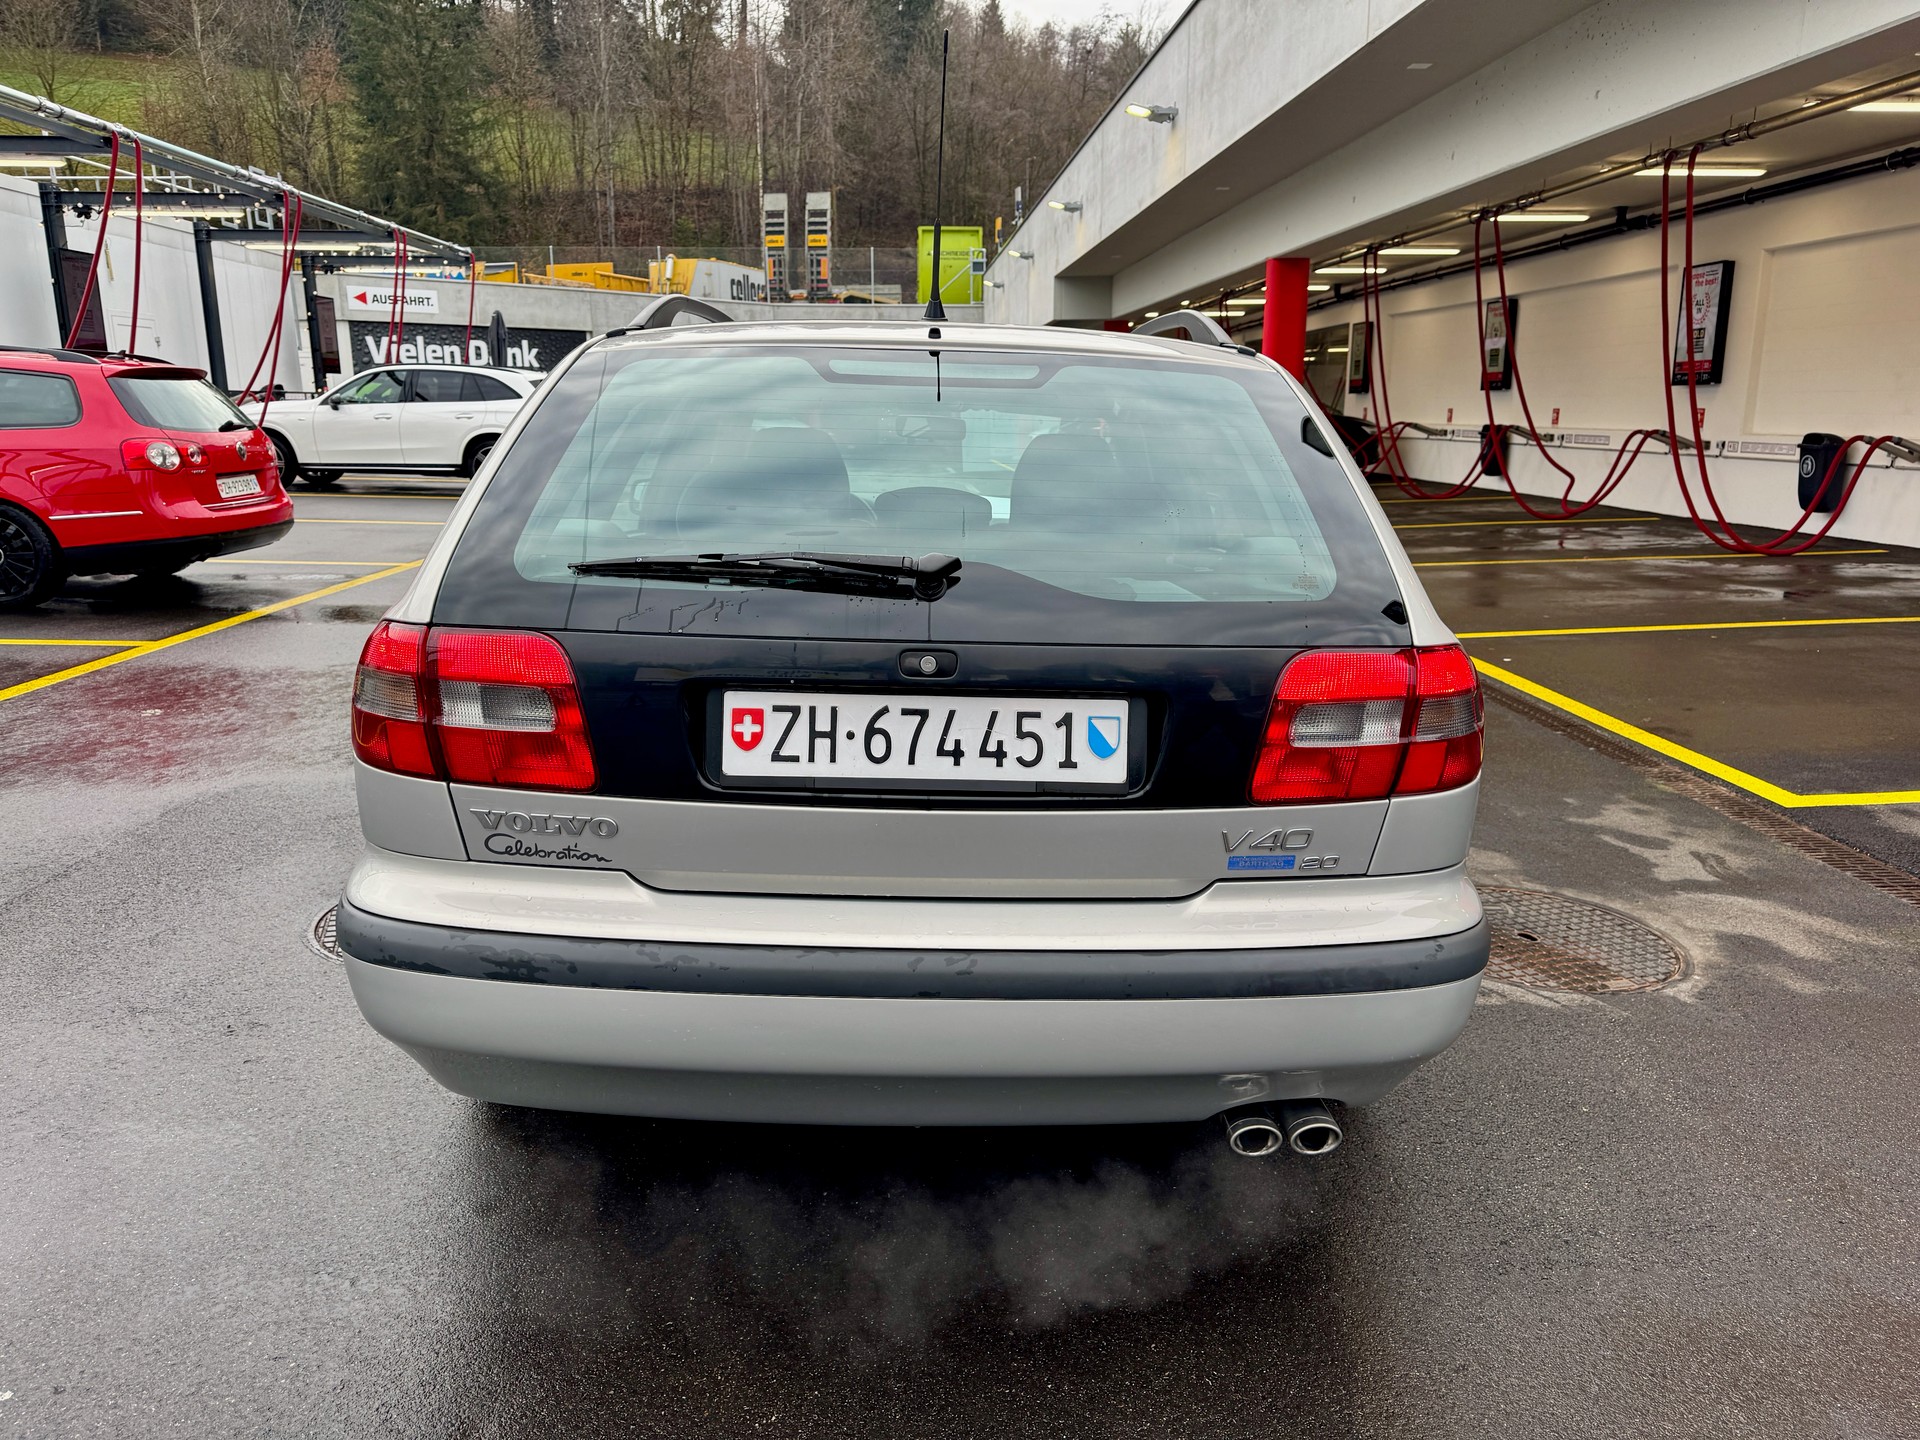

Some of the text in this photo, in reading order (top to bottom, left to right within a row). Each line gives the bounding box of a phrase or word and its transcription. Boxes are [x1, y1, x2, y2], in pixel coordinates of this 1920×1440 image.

[1695, 299, 1705, 307] ALL
[364, 334, 540, 368] Vielen Dnk
[469, 808, 619, 840] VOLVO
[483, 832, 613, 863] Celebration
